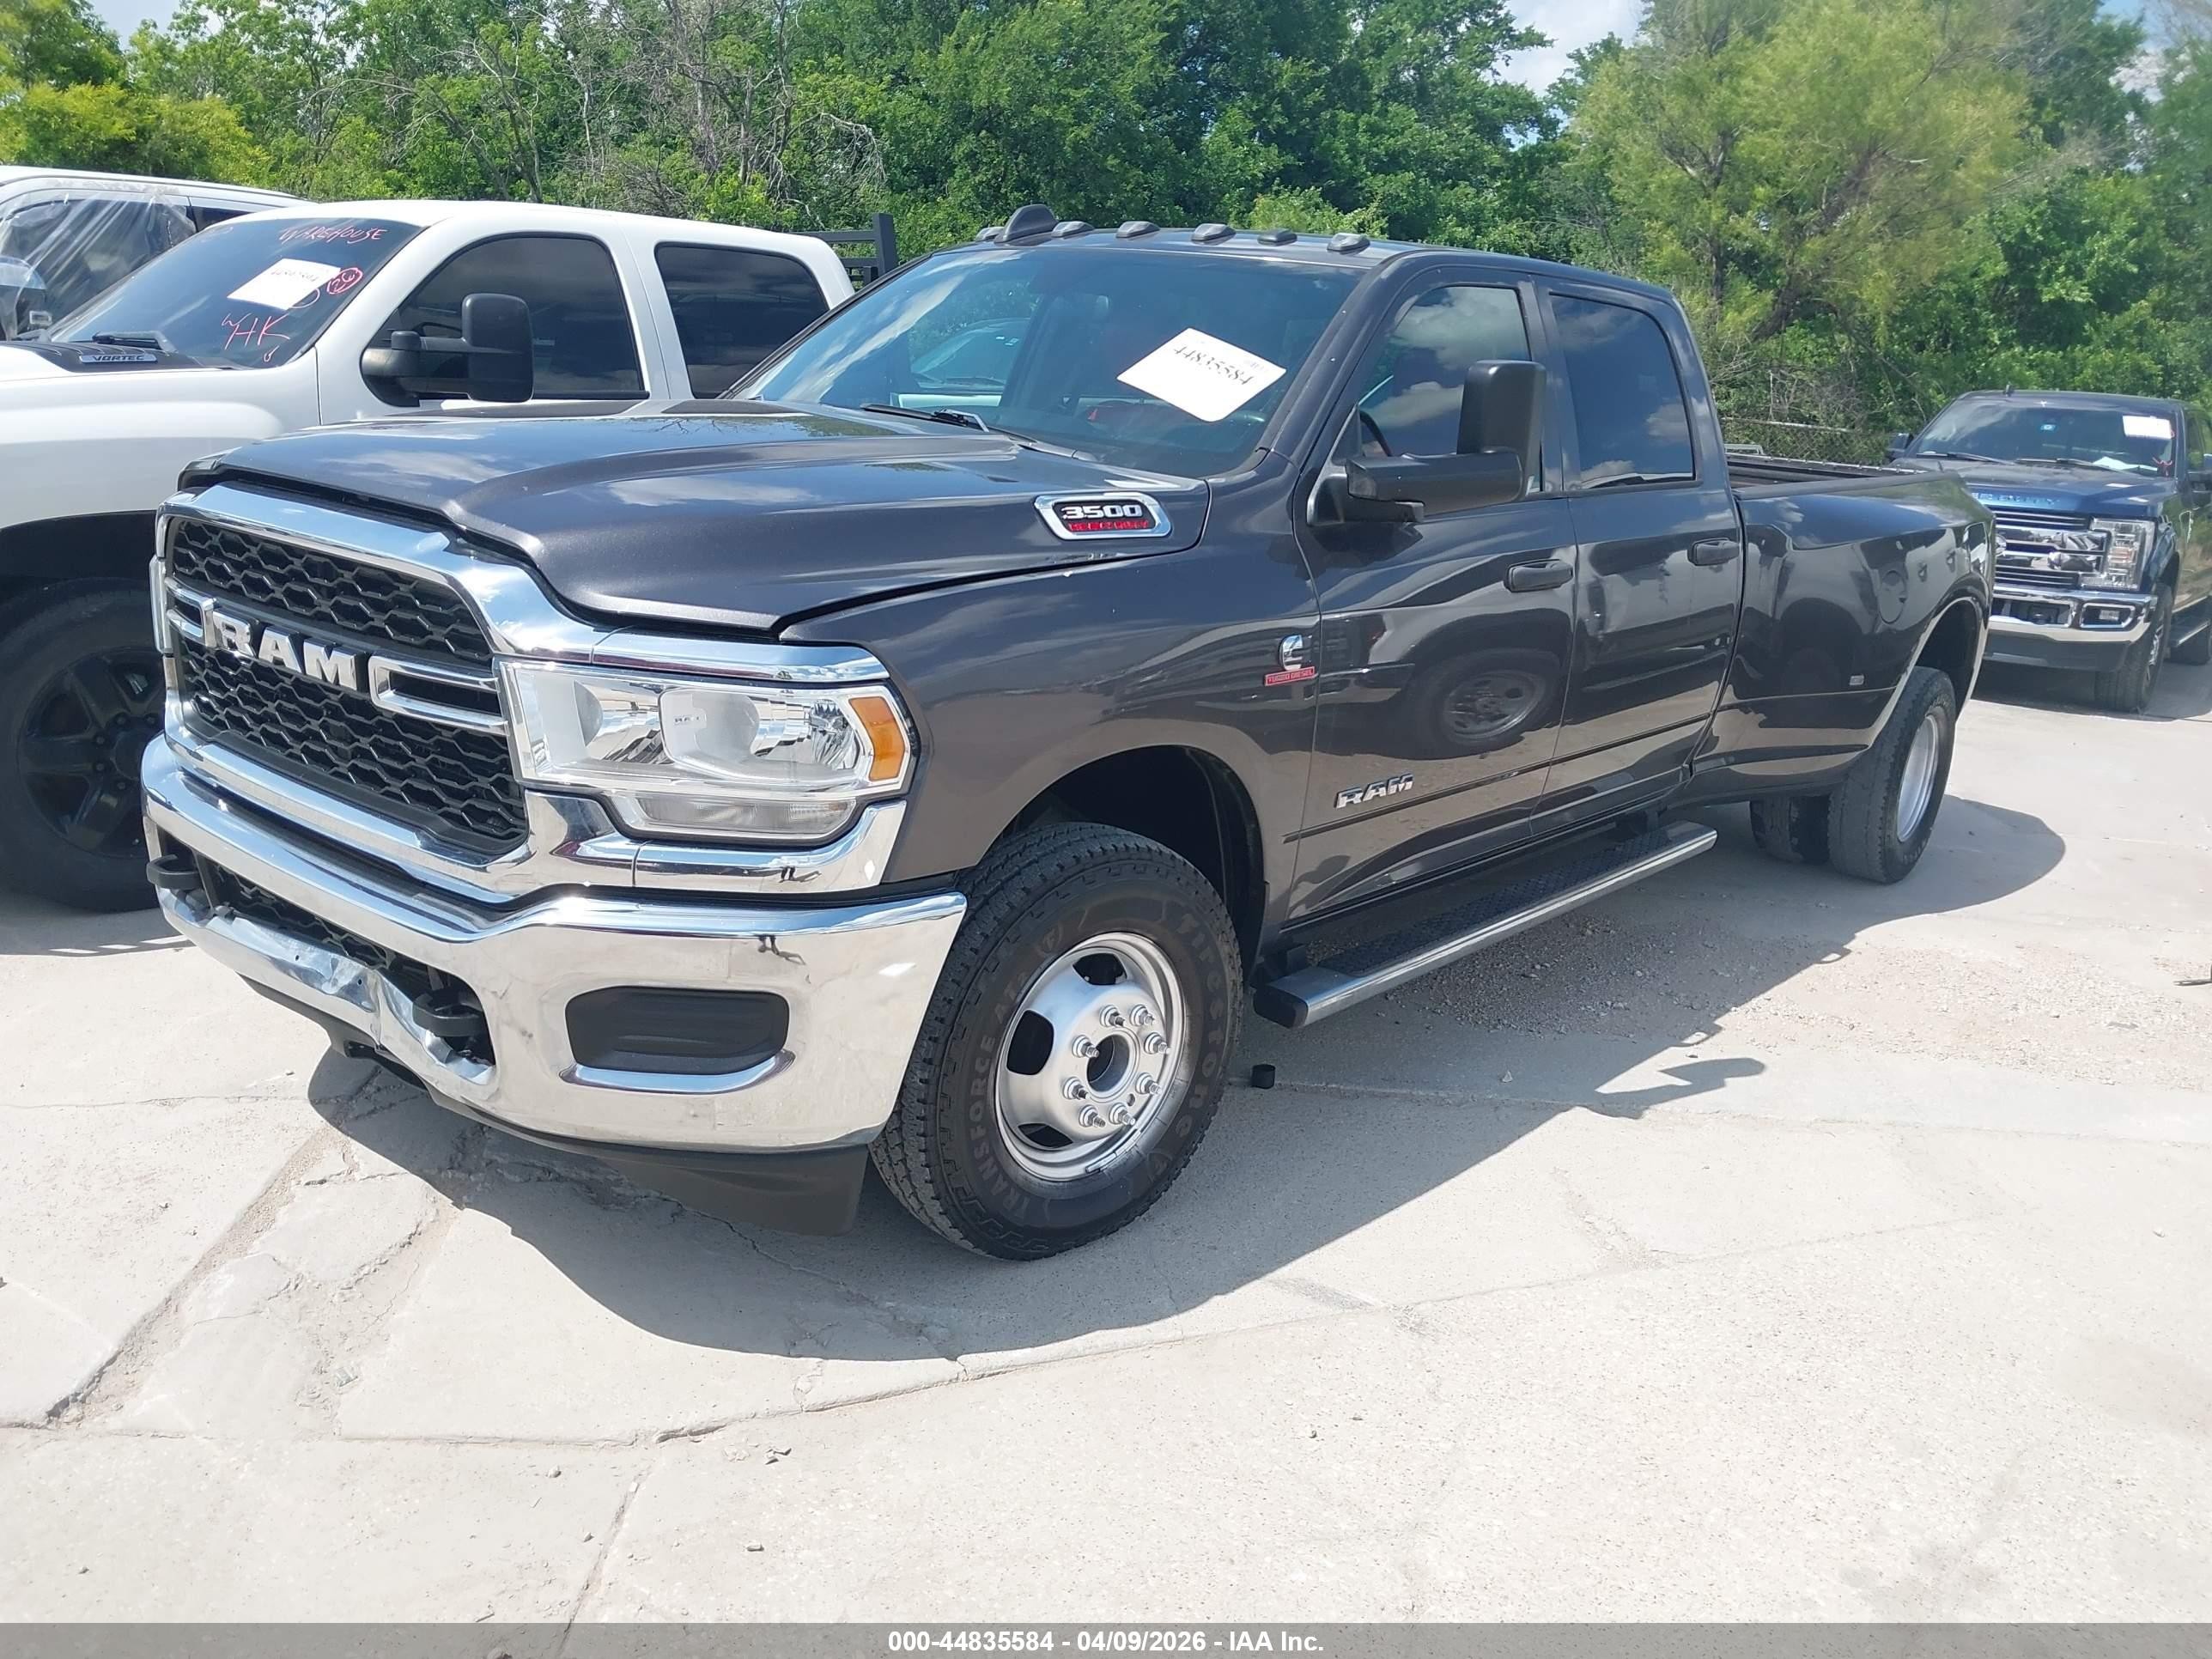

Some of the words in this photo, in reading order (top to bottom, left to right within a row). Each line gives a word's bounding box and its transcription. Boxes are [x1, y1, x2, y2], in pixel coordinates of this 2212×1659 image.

[278, 225, 386, 245] WAREHOUSE
[1173, 346, 1254, 385] 44835584
[1060, 504, 1143, 520] 3500
[211, 608, 359, 690] RAM
[1334, 773, 1413, 809] RAM
[969, 1036, 1031, 1220] TRANSFORCE
